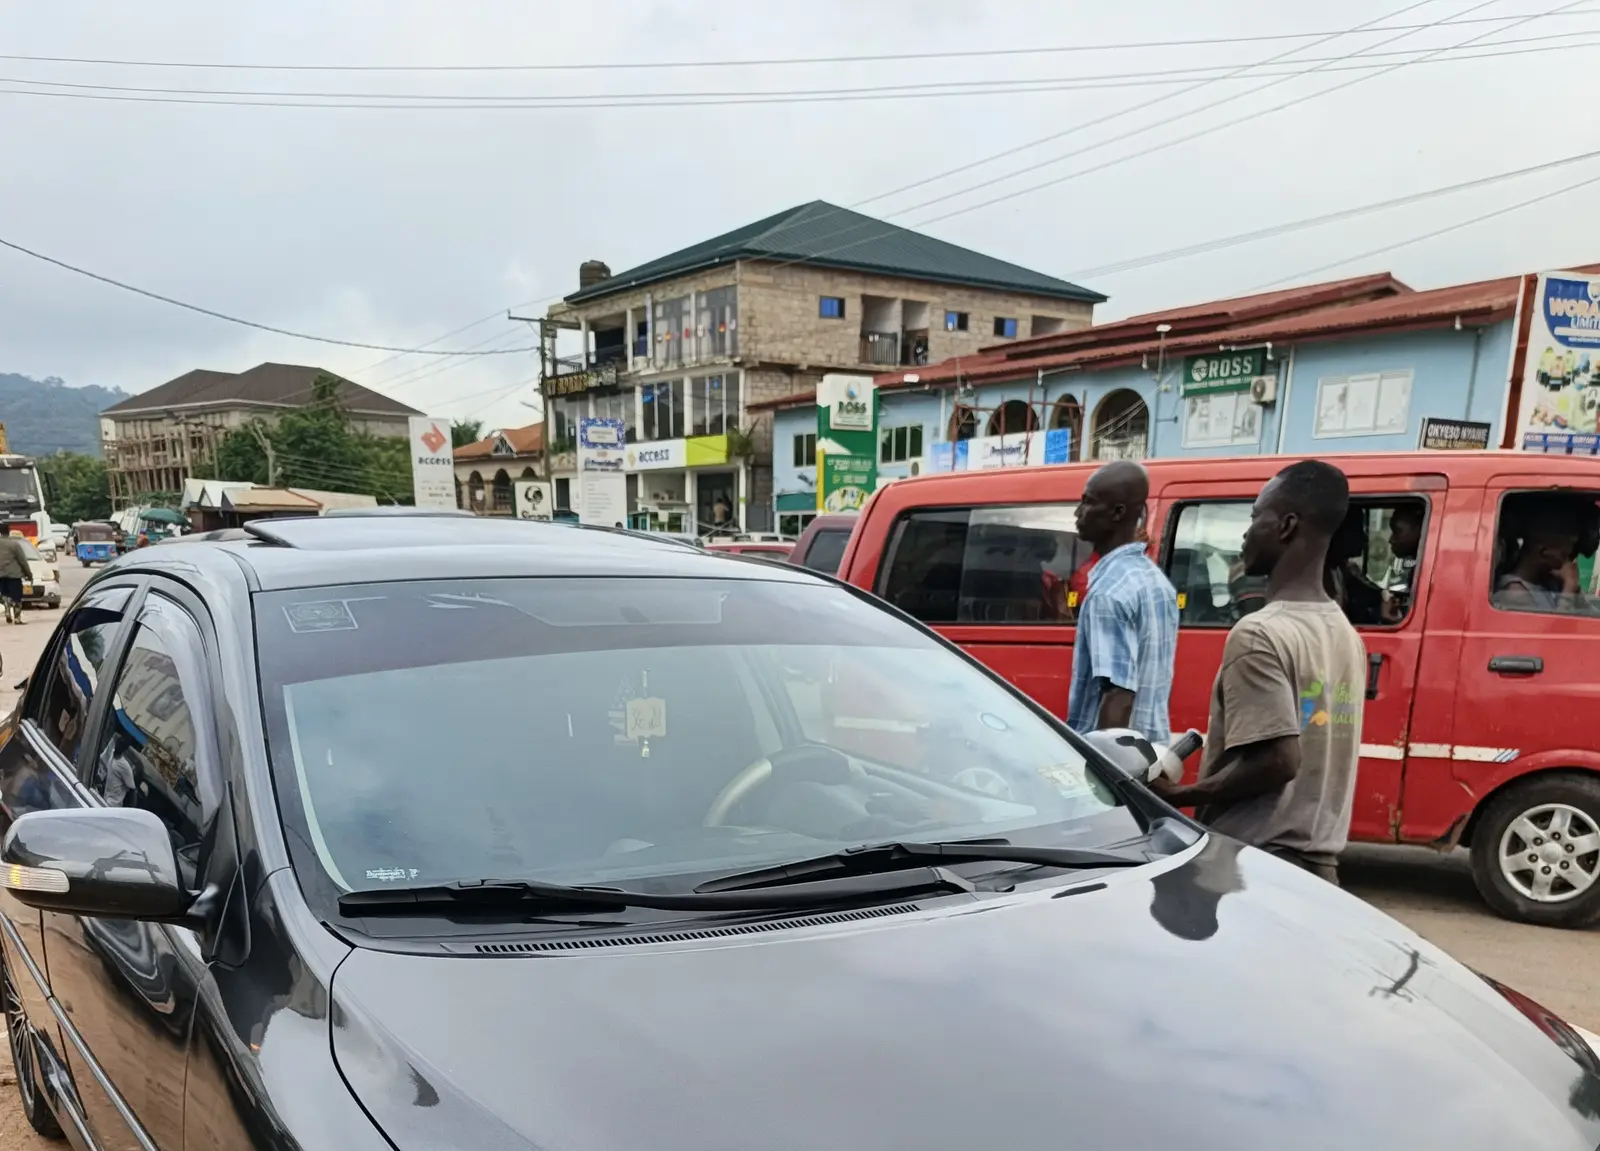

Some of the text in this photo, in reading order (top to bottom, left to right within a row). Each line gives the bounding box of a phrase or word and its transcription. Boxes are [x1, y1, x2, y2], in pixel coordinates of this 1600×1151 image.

[1208, 356, 1253, 378] ROSS
[418, 457, 451, 466] access
[639, 449, 670, 463] access
